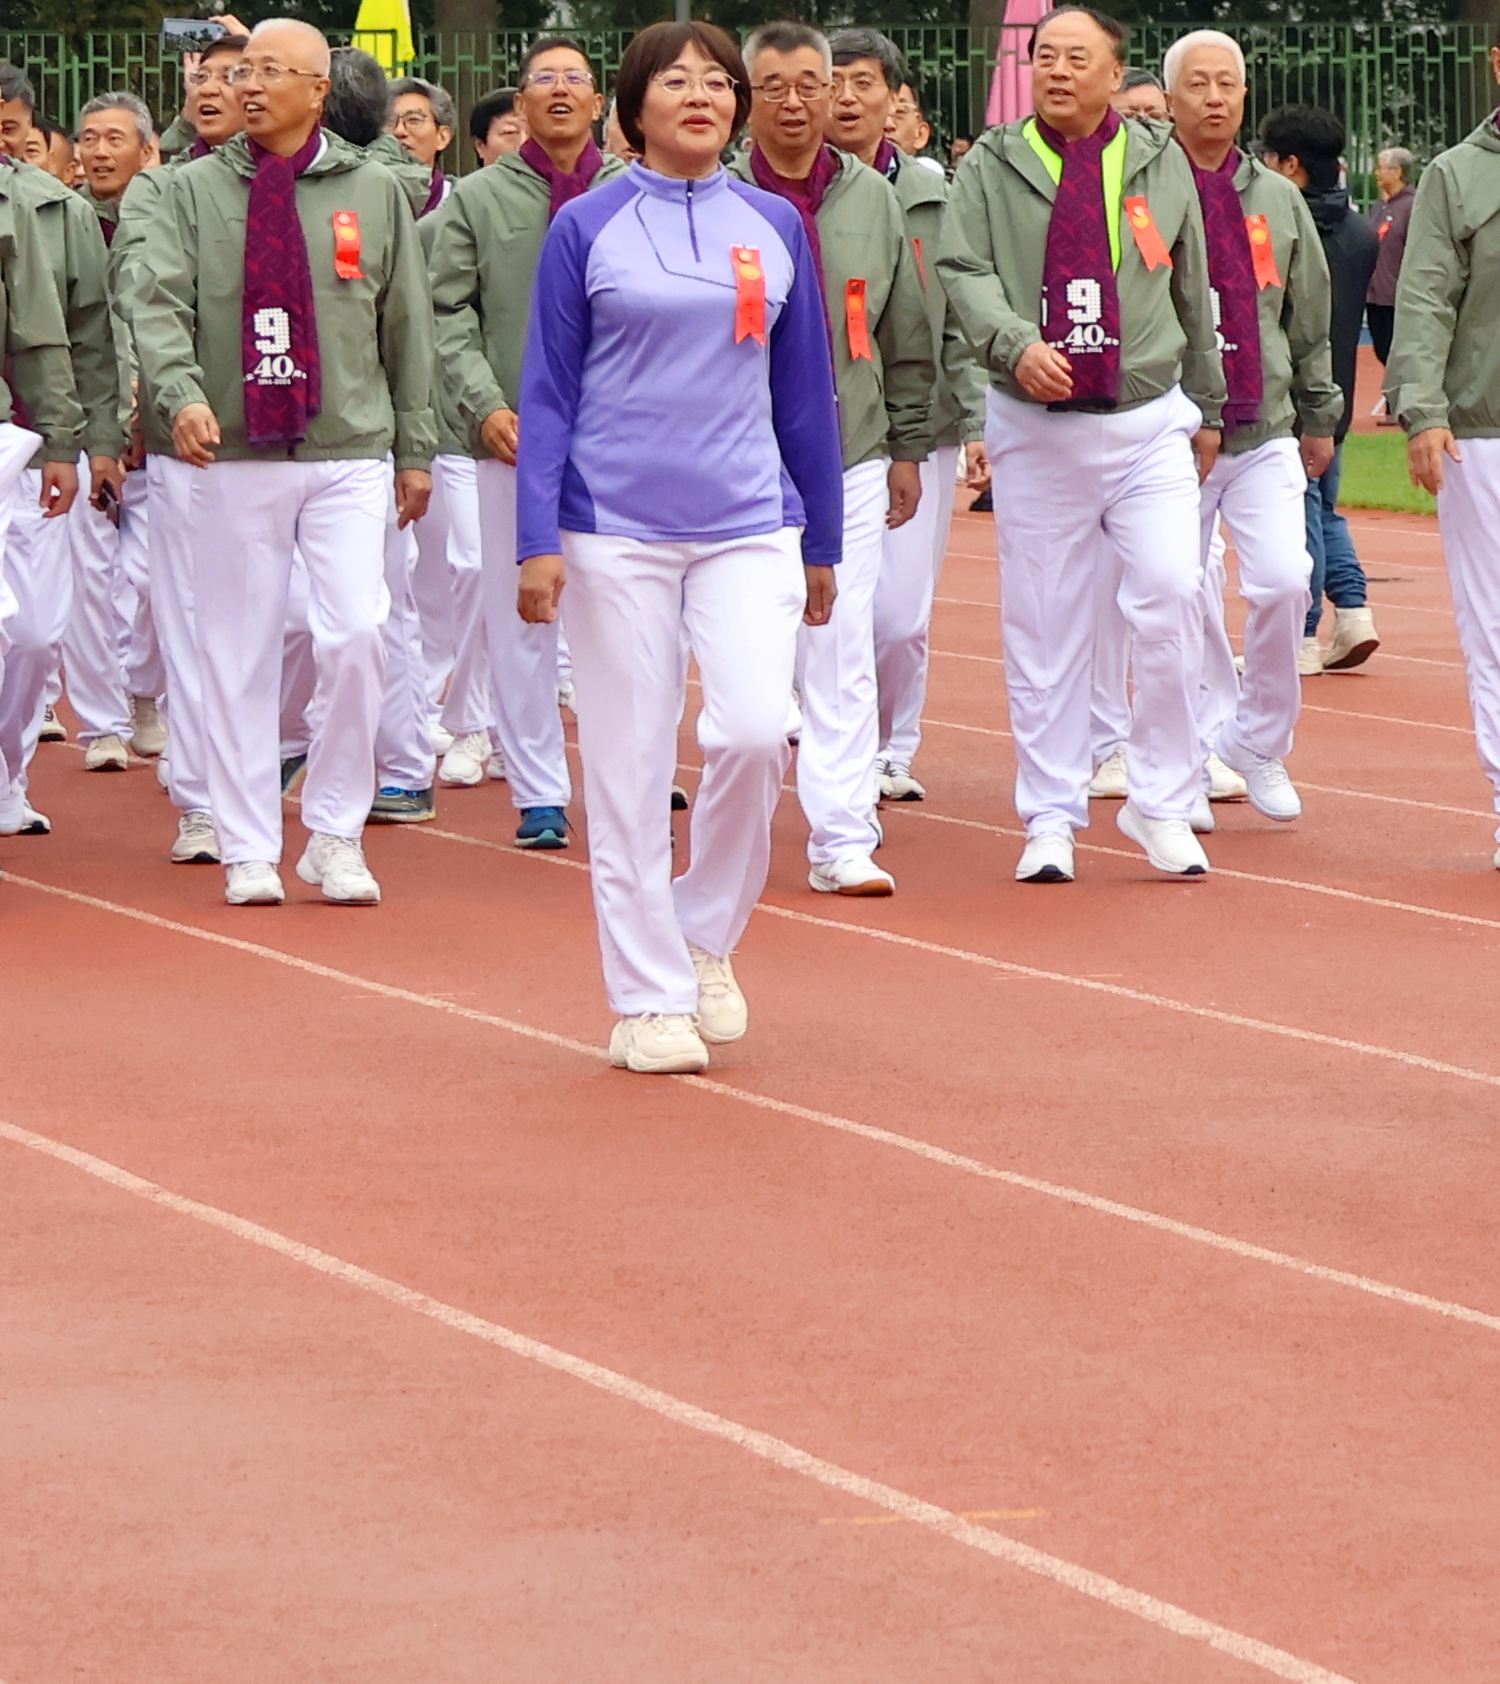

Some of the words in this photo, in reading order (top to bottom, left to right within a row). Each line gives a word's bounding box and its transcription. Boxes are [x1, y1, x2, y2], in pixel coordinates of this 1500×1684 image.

[1066, 278, 1103, 324] 9
[253, 306, 291, 354] 9
[1064, 324, 1106, 347] 40
[253, 355, 295, 379] 40
